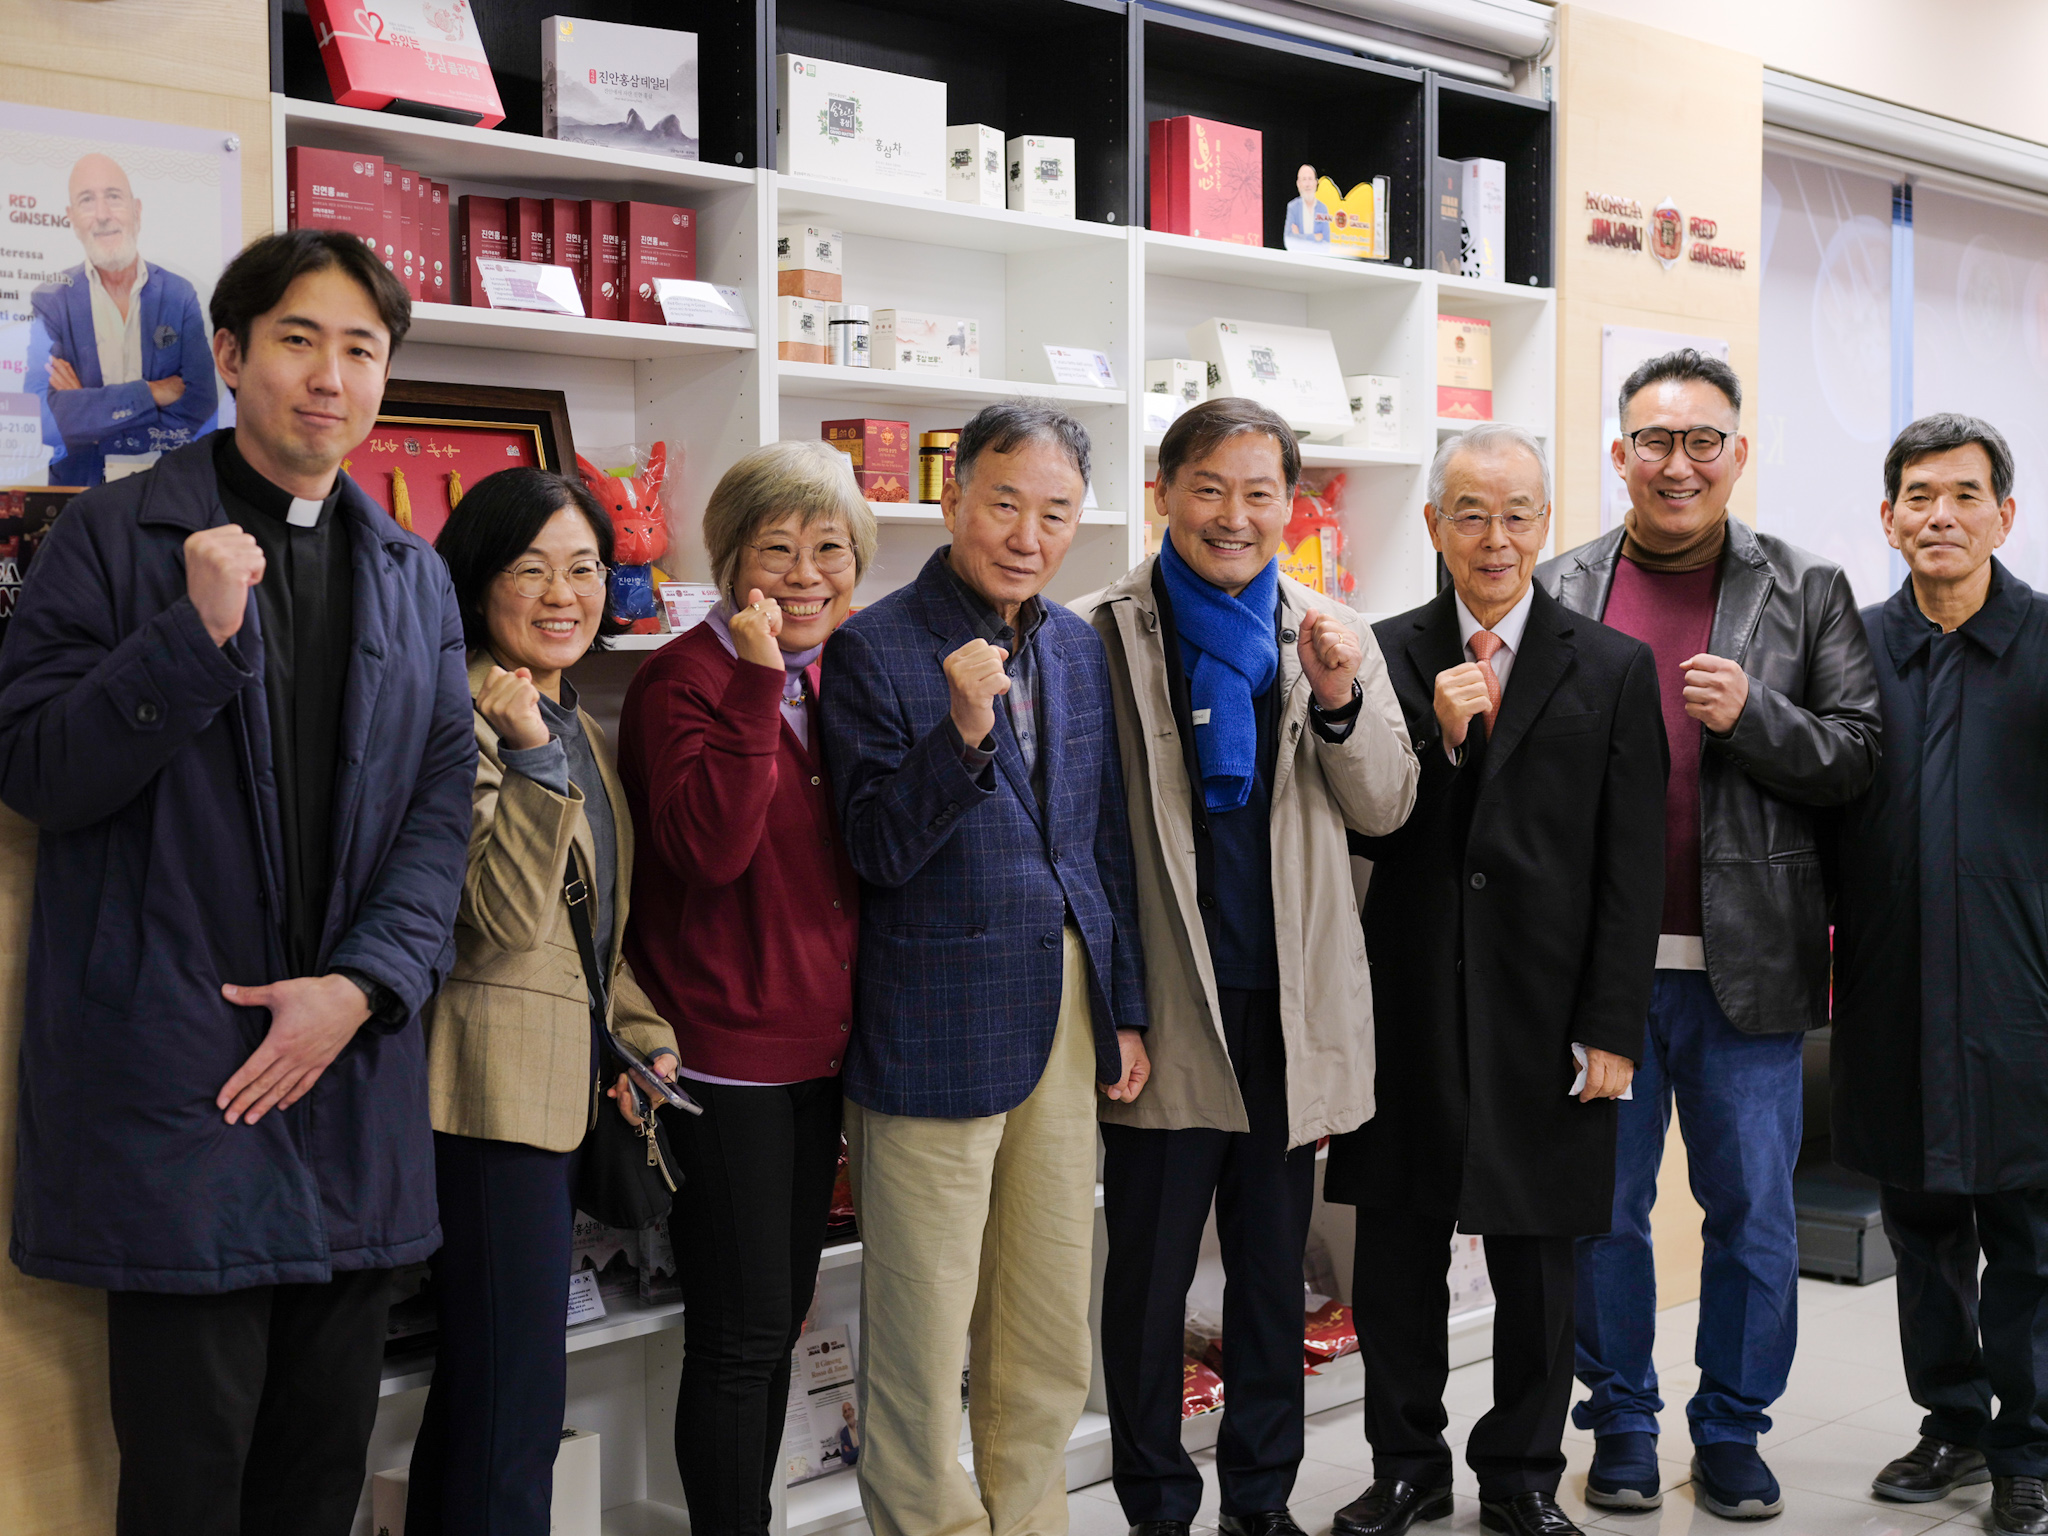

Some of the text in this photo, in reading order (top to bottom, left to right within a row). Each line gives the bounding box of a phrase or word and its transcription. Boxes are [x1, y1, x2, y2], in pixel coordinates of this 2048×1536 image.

[875, 138, 902, 159] 홍삼차
[9, 194, 37, 209] RED
[9, 210, 71, 228] GINSENG
[1689, 216, 1717, 240] RED
[0, 247, 44, 260] teressa
[1689, 242, 1746, 271] GINSENG
[17, 268, 74, 287] famiglia,
[13, 312, 35, 323] con
[820, 1357, 843, 1368] Ginseng
